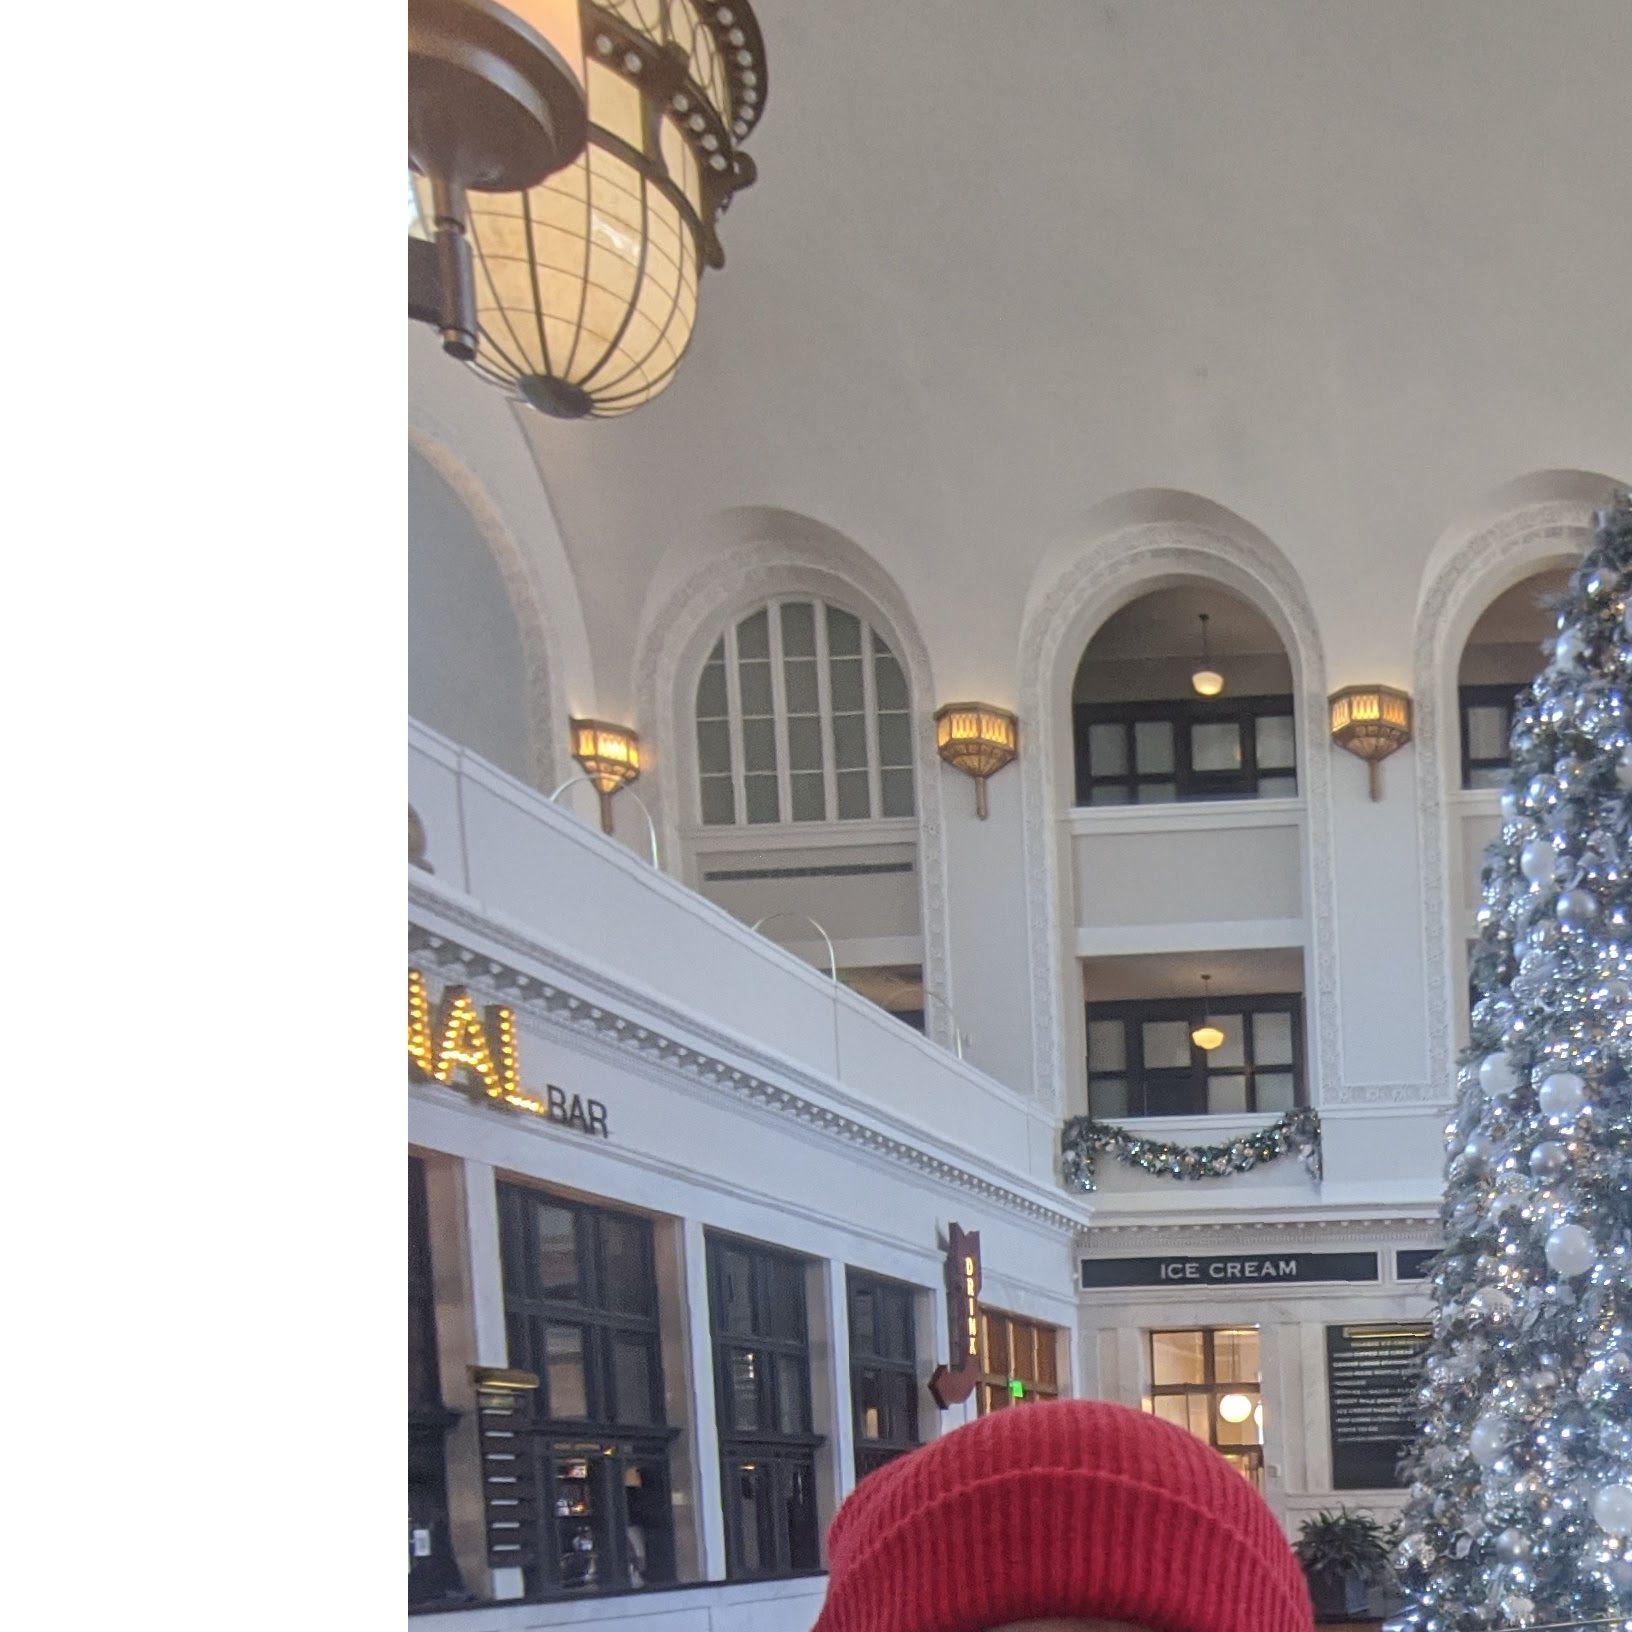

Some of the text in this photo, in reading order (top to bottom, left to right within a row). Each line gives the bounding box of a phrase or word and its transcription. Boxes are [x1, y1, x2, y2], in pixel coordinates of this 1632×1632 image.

[547, 1084, 608, 1138] BAR
[1160, 1260, 1298, 1280] ICE CREAM
[965, 1256, 977, 1356] DRINK
